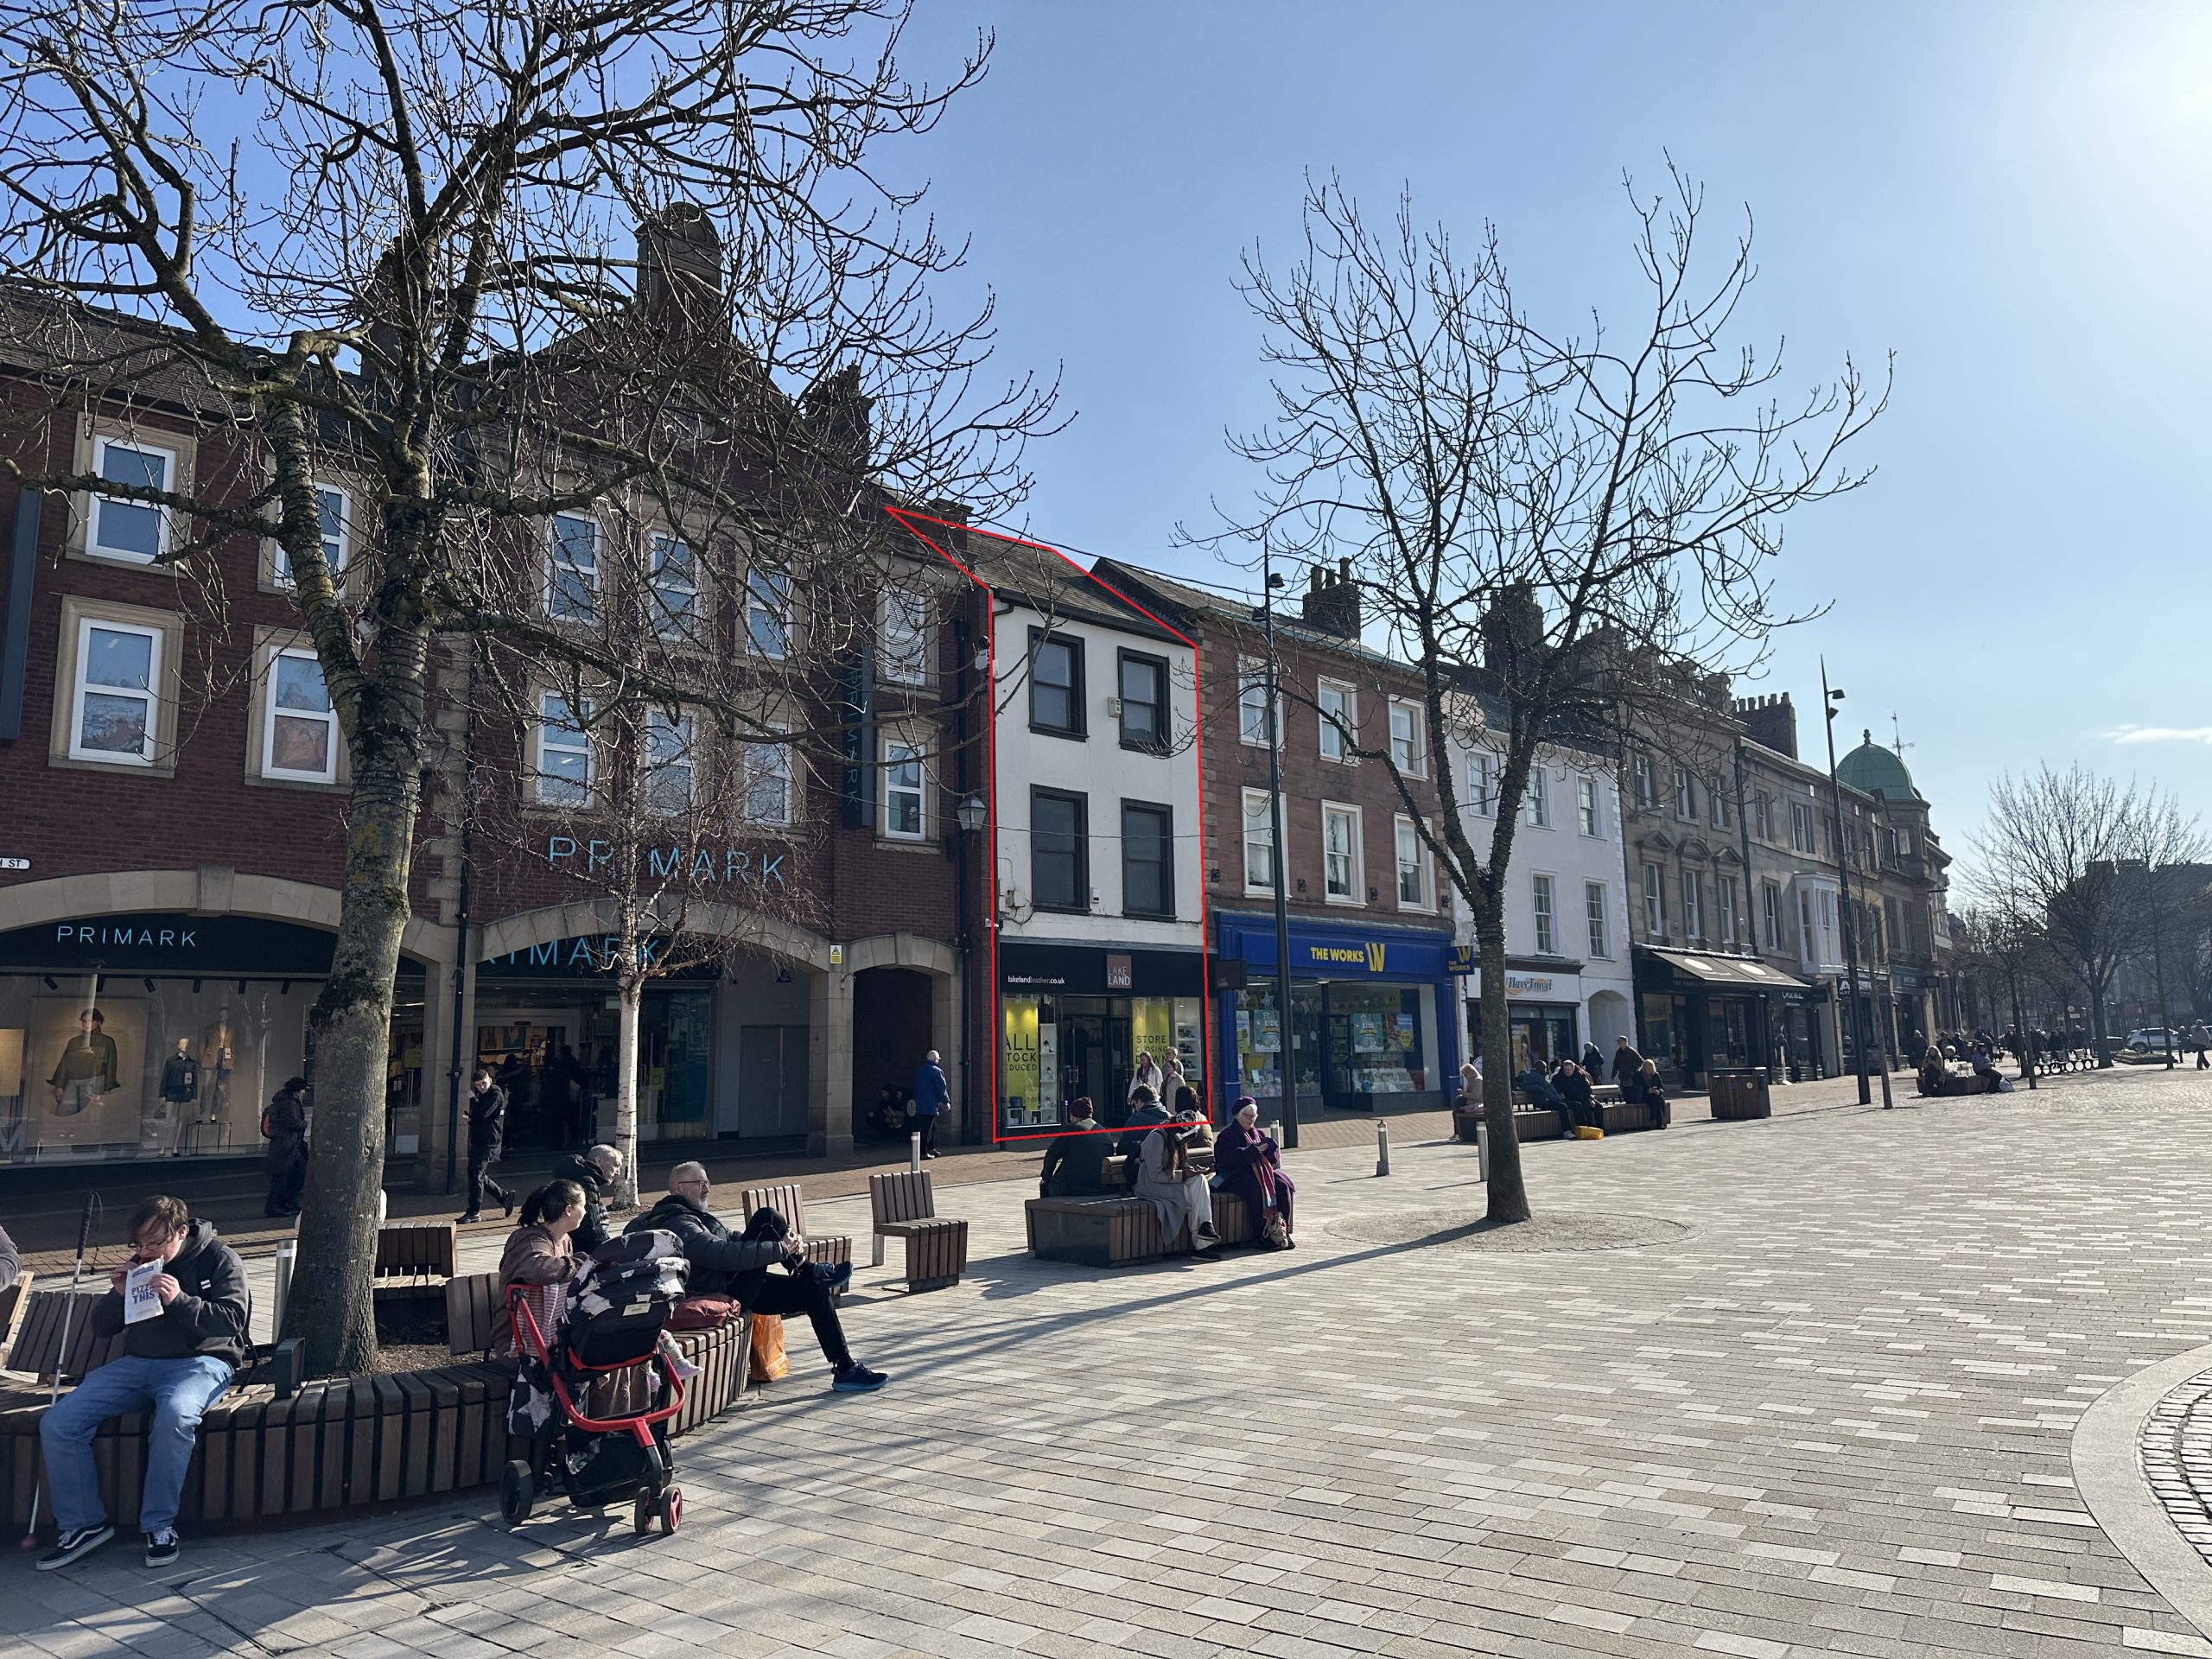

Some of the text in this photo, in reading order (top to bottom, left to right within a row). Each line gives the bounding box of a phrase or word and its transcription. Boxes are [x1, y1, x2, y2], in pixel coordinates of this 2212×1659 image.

[846, 668, 859, 810] PRIMARK
[8, 859, 22, 868] ST
[548, 836, 786, 887] PRMARK
[56, 925, 196, 948] PRIMARK
[1310, 942, 1386, 972] THE WORKS W
[1108, 966, 1128, 976] LAKE
[1007, 974, 1065, 985] lakelandleather.co.uk
[1108, 975, 1131, 986] LAND
[1508, 976, 1553, 991] Hays Travel
[1136, 1035, 1166, 1044] STORE
[1006, 1052, 1037, 1063] TOCK
[1135, 1055, 1167, 1065] DWN
[131, 1283, 152, 1296] PIZZ
[132, 1290, 156, 1304] THIS
